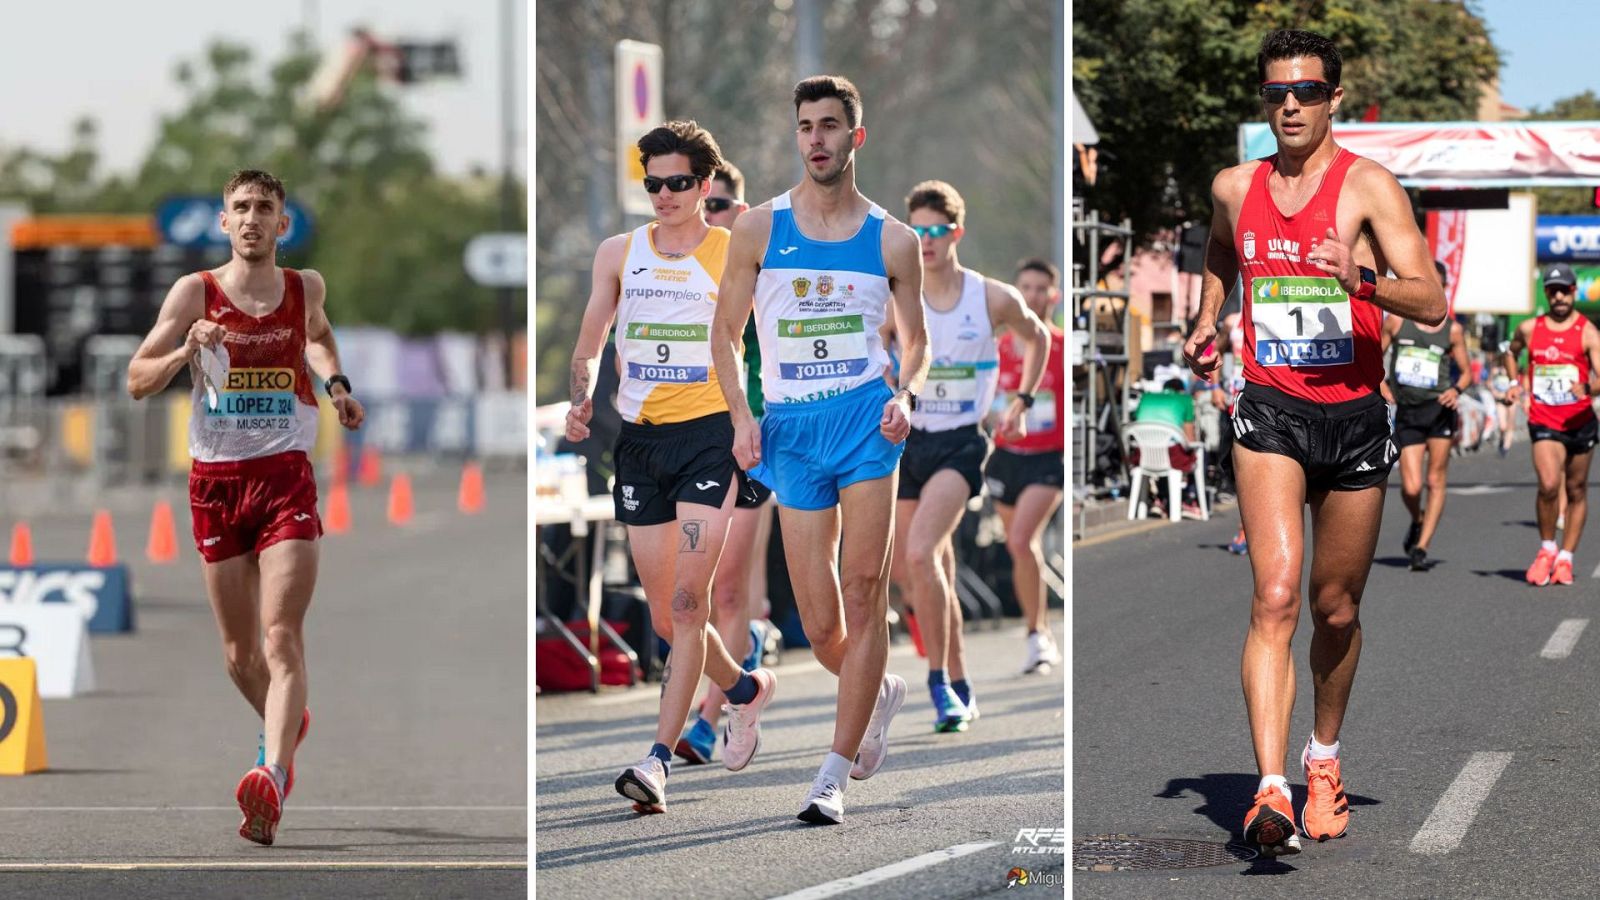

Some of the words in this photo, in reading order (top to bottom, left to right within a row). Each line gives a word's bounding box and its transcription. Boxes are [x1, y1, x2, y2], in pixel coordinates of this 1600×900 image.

[625, 288, 702, 302] grupompleo
[1281, 286, 1342, 297] IBERDROLA
[803, 322, 851, 333] IBERDROLA
[1288, 307, 1304, 336] 1
[223, 328, 293, 346] ESPAÑA
[650, 329, 696, 337] IBERDROLA
[656, 343, 670, 363] 9
[813, 339, 829, 359] 8
[225, 372, 292, 389] EIKO
[935, 382, 946, 398] 6
[227, 394, 274, 414] LÓPEZ
[236, 418, 276, 430] MUSCAT
[278, 418, 290, 429] 22
